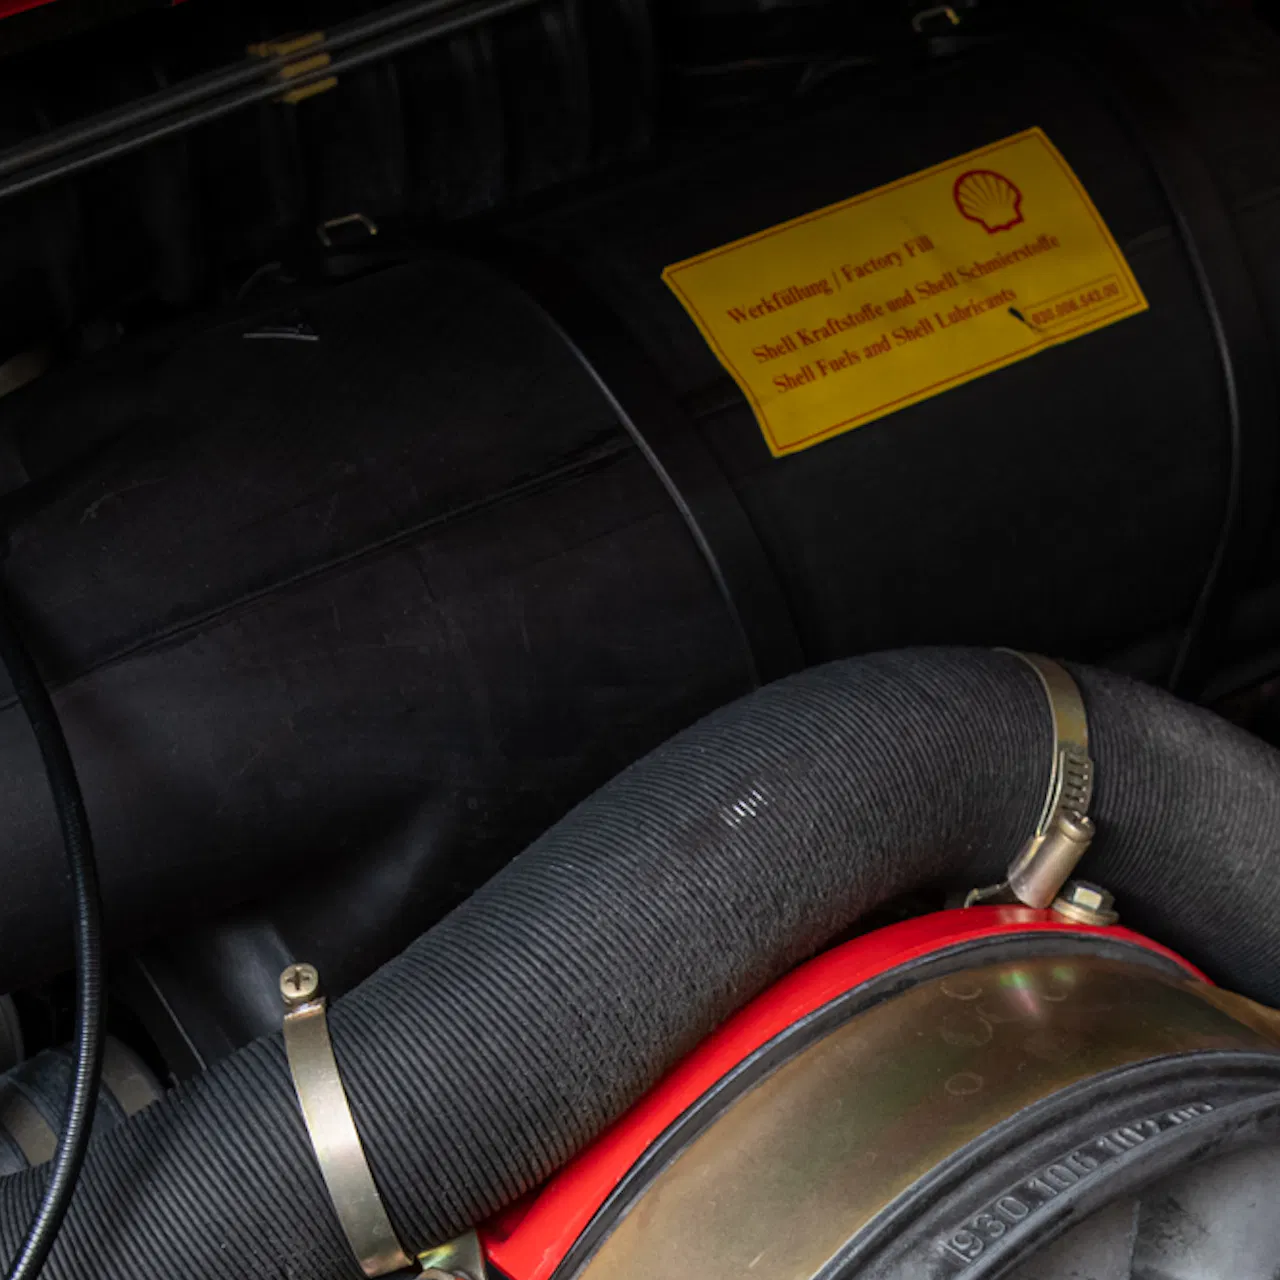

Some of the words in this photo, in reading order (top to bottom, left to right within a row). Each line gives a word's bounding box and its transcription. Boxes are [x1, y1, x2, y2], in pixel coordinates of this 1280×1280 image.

[726, 279, 834, 323] Werkfüllung
[831, 270, 842, 290] /
[840, 251, 902, 282] Factory
[903, 234, 935, 258] Fill
[752, 335, 798, 360] Shell
[795, 302, 885, 346] Kraftstoffe
[885, 289, 916, 313] und
[915, 271, 959, 297] Shell
[956, 234, 1060, 281] Schmierstoffe
[773, 364, 816, 390] Shell
[814, 349, 861, 377] Fuels
[863, 333, 892, 359] and
[891, 317, 935, 342] Shell
[933, 289, 1017, 329] Lubricants
